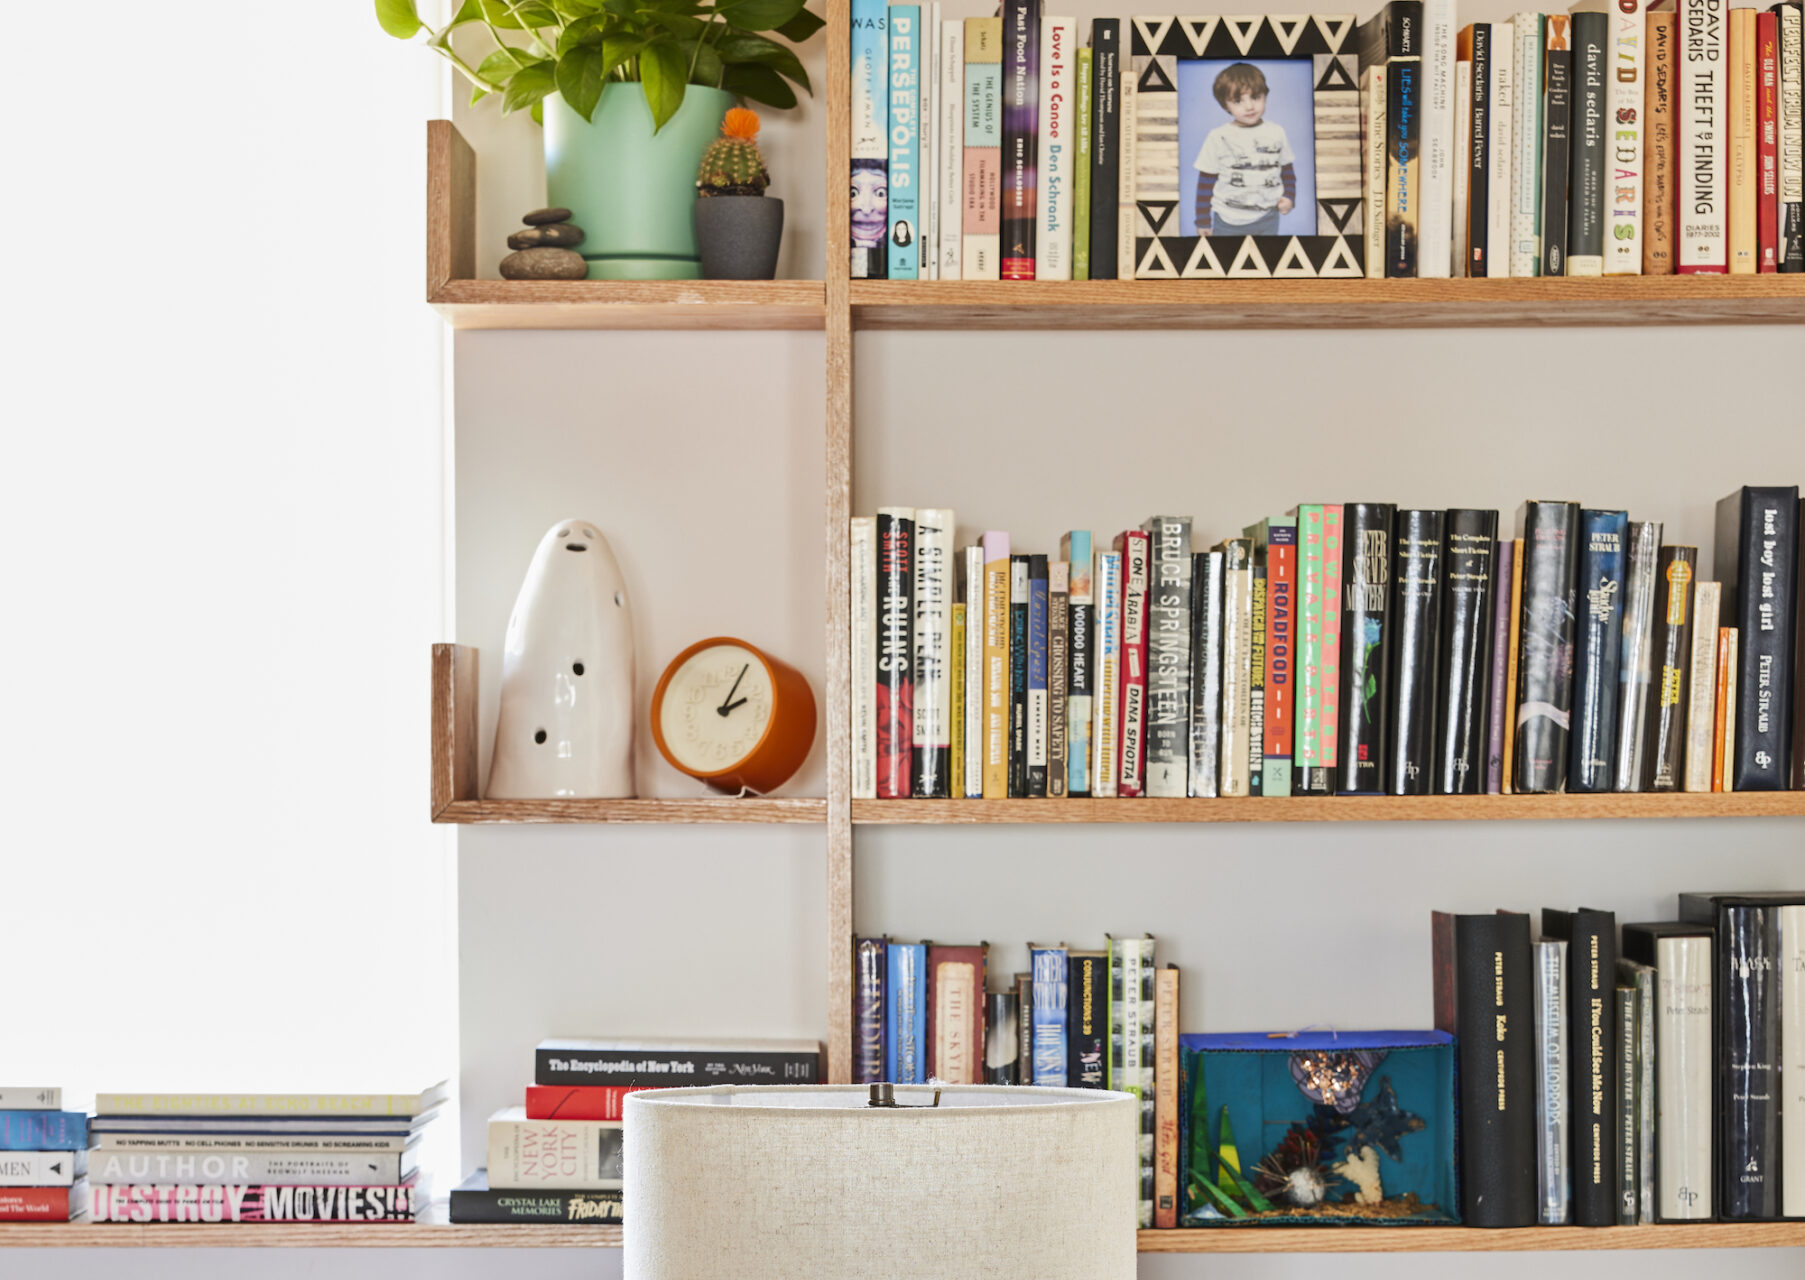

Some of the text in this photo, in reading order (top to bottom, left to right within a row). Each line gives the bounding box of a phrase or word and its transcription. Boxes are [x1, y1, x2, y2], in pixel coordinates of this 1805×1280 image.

[851, 18, 886, 30] WAS
[1016, 7, 1027, 106] Fast Food Nation
[1401, 17, 1410, 53] SCHWARTZ
[1616, 0, 1639, 83] DAVID
[1688, 0, 1720, 62] DAVID SEDARIS
[864, 48, 872, 129] GEOFF RYMAN
[1050, 26, 1065, 138] Love Is a Canoe
[1401, 68, 1412, 93] LIES
[1475, 30, 1485, 101] David Sedaris
[1498, 68, 1511, 107] naked
[1586, 43, 1601, 147] david sedaris
[1655, 25, 1667, 114] DAVID SEDARIS
[891, 17, 911, 188] PERSEPOLIS
[1783, 14, 1802, 197] PERFECT FROM NOW ON
[1373, 111, 1385, 180] Nine Stories
[1473, 108, 1484, 169] Barrel Fever
[1695, 70, 1713, 215] THEFT BY FINDING
[1048, 145, 1061, 232] Ben Schrank
[1398, 142, 1409, 213] SOMEWHERE
[1613, 108, 1638, 241] SEDARIS
[882, 532, 894, 573] SMITH
[895, 531, 908, 573] SCOTT
[1589, 543, 1620, 552] STRAUB
[1591, 532, 1619, 542] PETER
[1126, 539, 1144, 641] STONE ARABIA
[1758, 509, 1777, 631] lost boy lost girl
[879, 596, 909, 672] RUINS
[1073, 605, 1085, 689] VOODOO HEART
[1157, 523, 1181, 724] BRUCE SPRINGSTEEN
[1273, 582, 1289, 684] ROADFOOD
[1303, 512, 1319, 760] PRIVATE PARTS
[1322, 513, 1338, 760] HOWARD STERN
[1052, 636, 1066, 761] CROSSING TO SAFETY
[1758, 655, 1773, 732] PETER STRAUB
[1124, 687, 1139, 780] DANA SPIOTTA
[1495, 977, 1503, 1006] STRAUB
[1591, 935, 1599, 990] PETER STRAUB
[1128, 958, 1136, 1067] PETER STRAUB
[1496, 1014, 1507, 1041] Koko
[1592, 1007, 1602, 1026] You
[1592, 1026, 1602, 1056] Could
[548, 1059, 694, 1074] The Encyclopedia of New York
[1592, 1056, 1602, 1074] See
[1592, 1091, 1602, 1115] Now
[103, 1155, 250, 1179] AUTHOR
[523, 1129, 538, 1177] NEW
[541, 1126, 558, 1180] YORK
[560, 1129, 577, 1177] CITY
[1740, 1175, 1763, 1184] GRANT
[89, 1185, 247, 1222] DESTROY
[497, 1198, 561, 1208] CRYSTAL LAKE
[511, 1207, 562, 1216] MEMORIES
